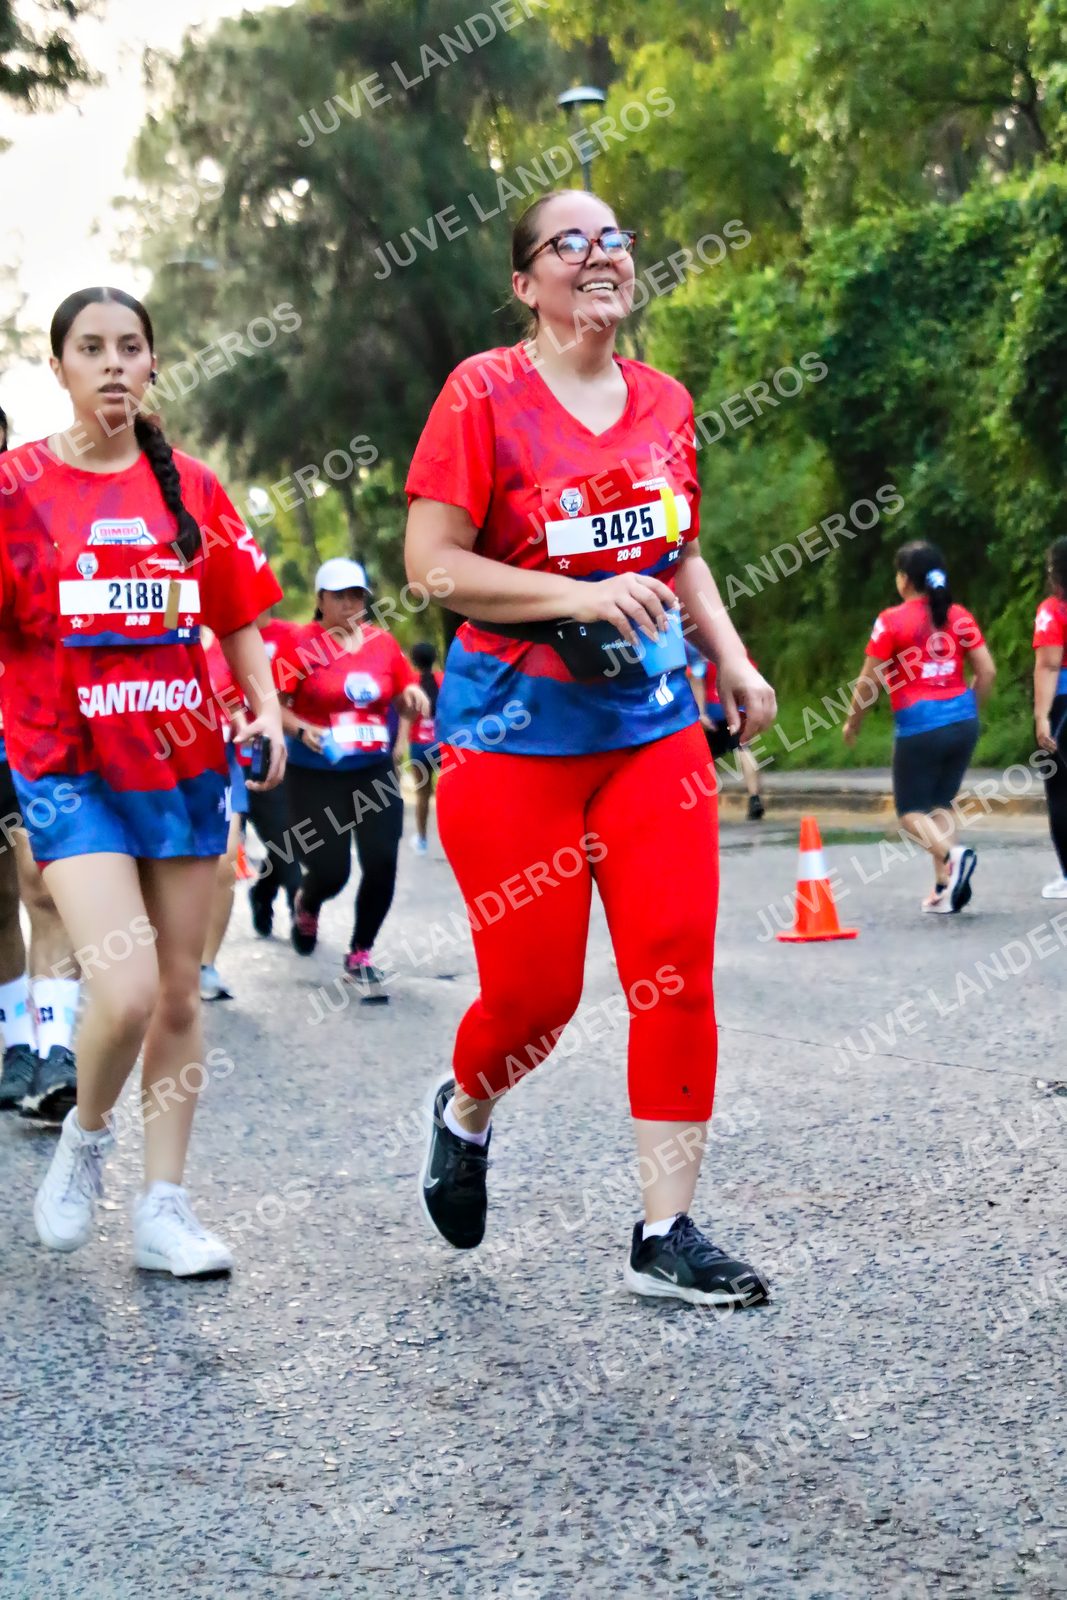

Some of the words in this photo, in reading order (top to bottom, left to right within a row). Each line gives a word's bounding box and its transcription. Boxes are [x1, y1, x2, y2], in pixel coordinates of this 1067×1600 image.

[99, 526, 139, 538] BIMBO
[591, 506, 654, 548] 3425
[108, 582, 163, 610] 2188
[77, 677, 203, 718] SANTIAGO
